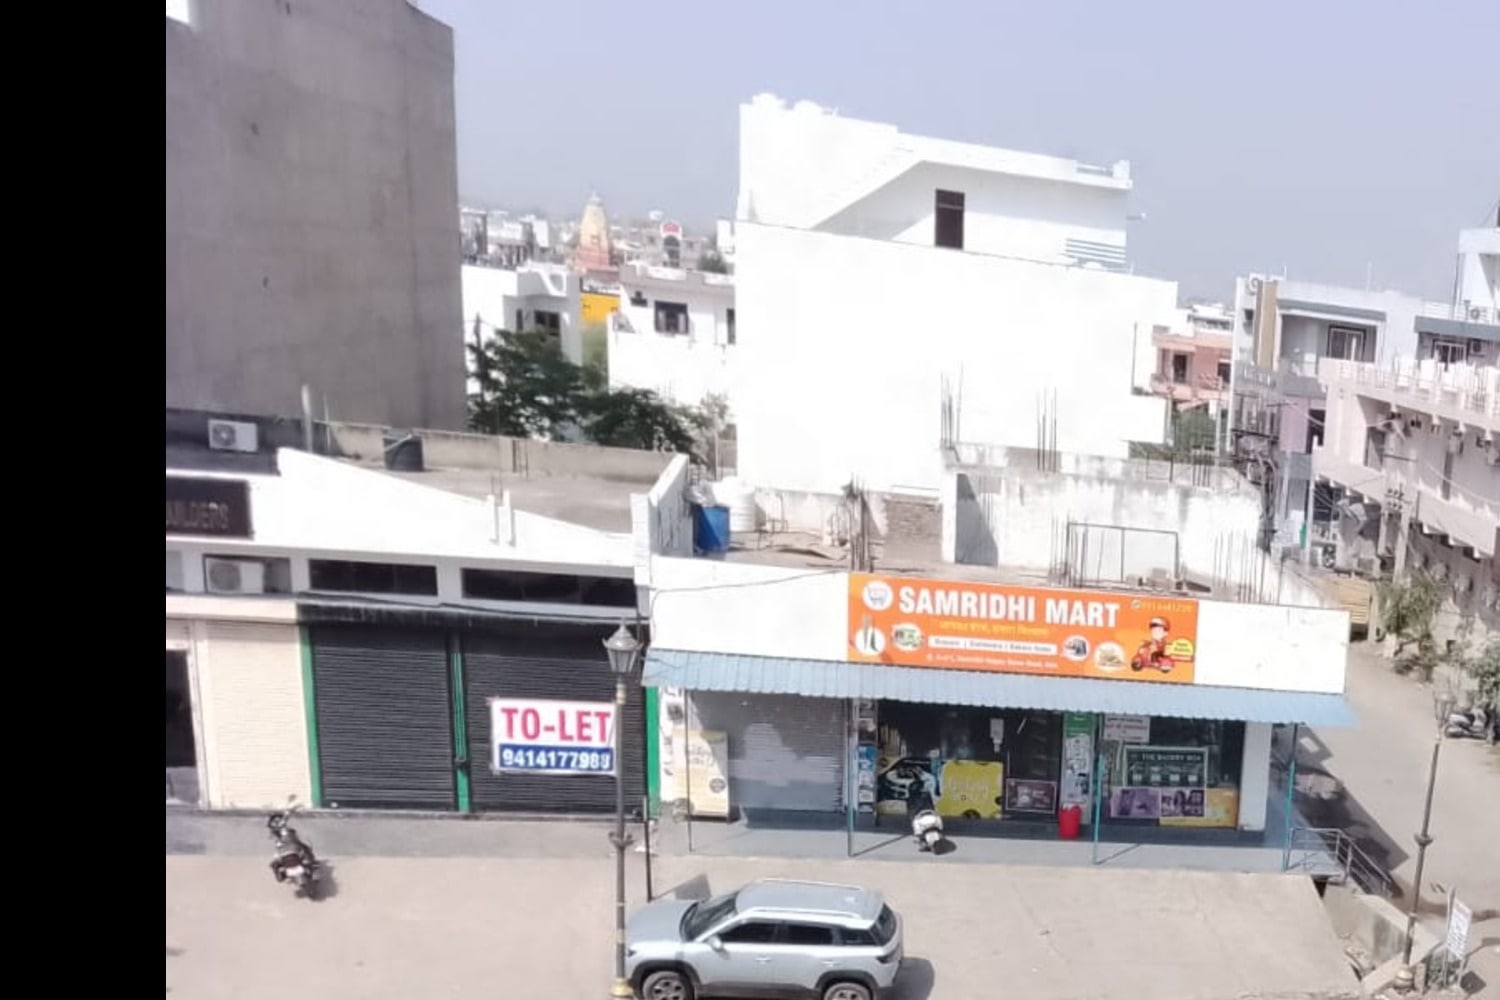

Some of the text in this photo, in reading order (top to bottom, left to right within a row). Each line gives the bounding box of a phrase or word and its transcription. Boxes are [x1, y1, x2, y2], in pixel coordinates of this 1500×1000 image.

[899, 586, 1035, 622] SAMRIDHI
[1045, 598, 1120, 628] MART
[501, 708, 611, 742] TO-LET
